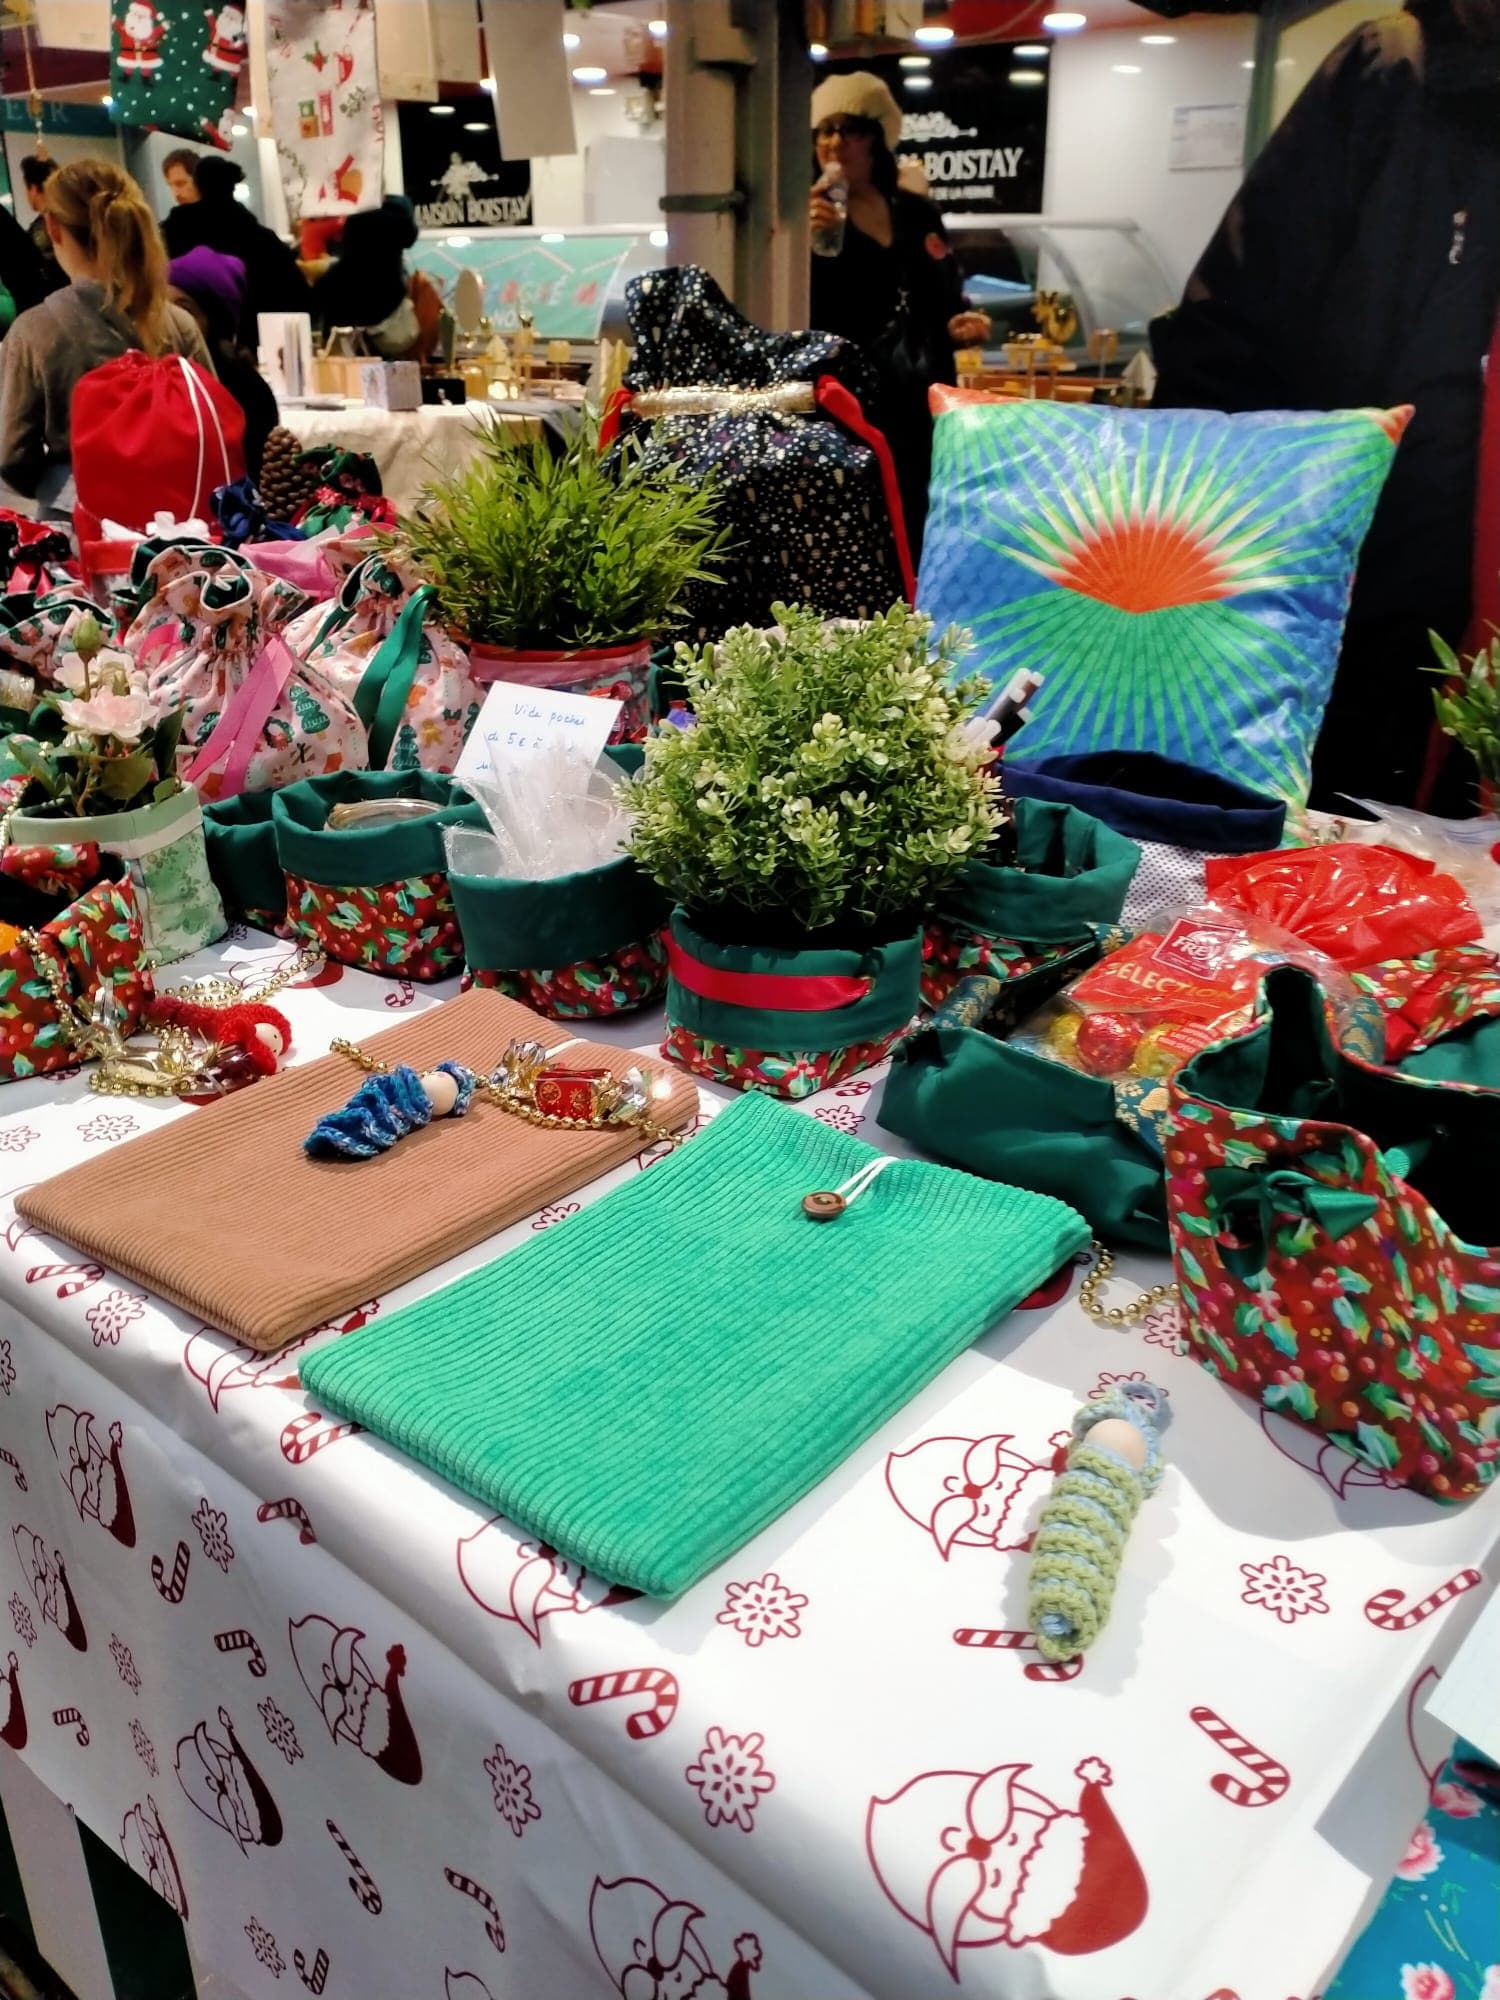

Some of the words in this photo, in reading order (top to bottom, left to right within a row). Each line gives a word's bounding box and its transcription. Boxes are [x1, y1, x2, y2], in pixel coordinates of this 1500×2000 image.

[924, 147, 1024, 181] BOISTAY
[467, 195, 531, 223] BOISTAY
[1105, 961, 1239, 1000] SELECTION
